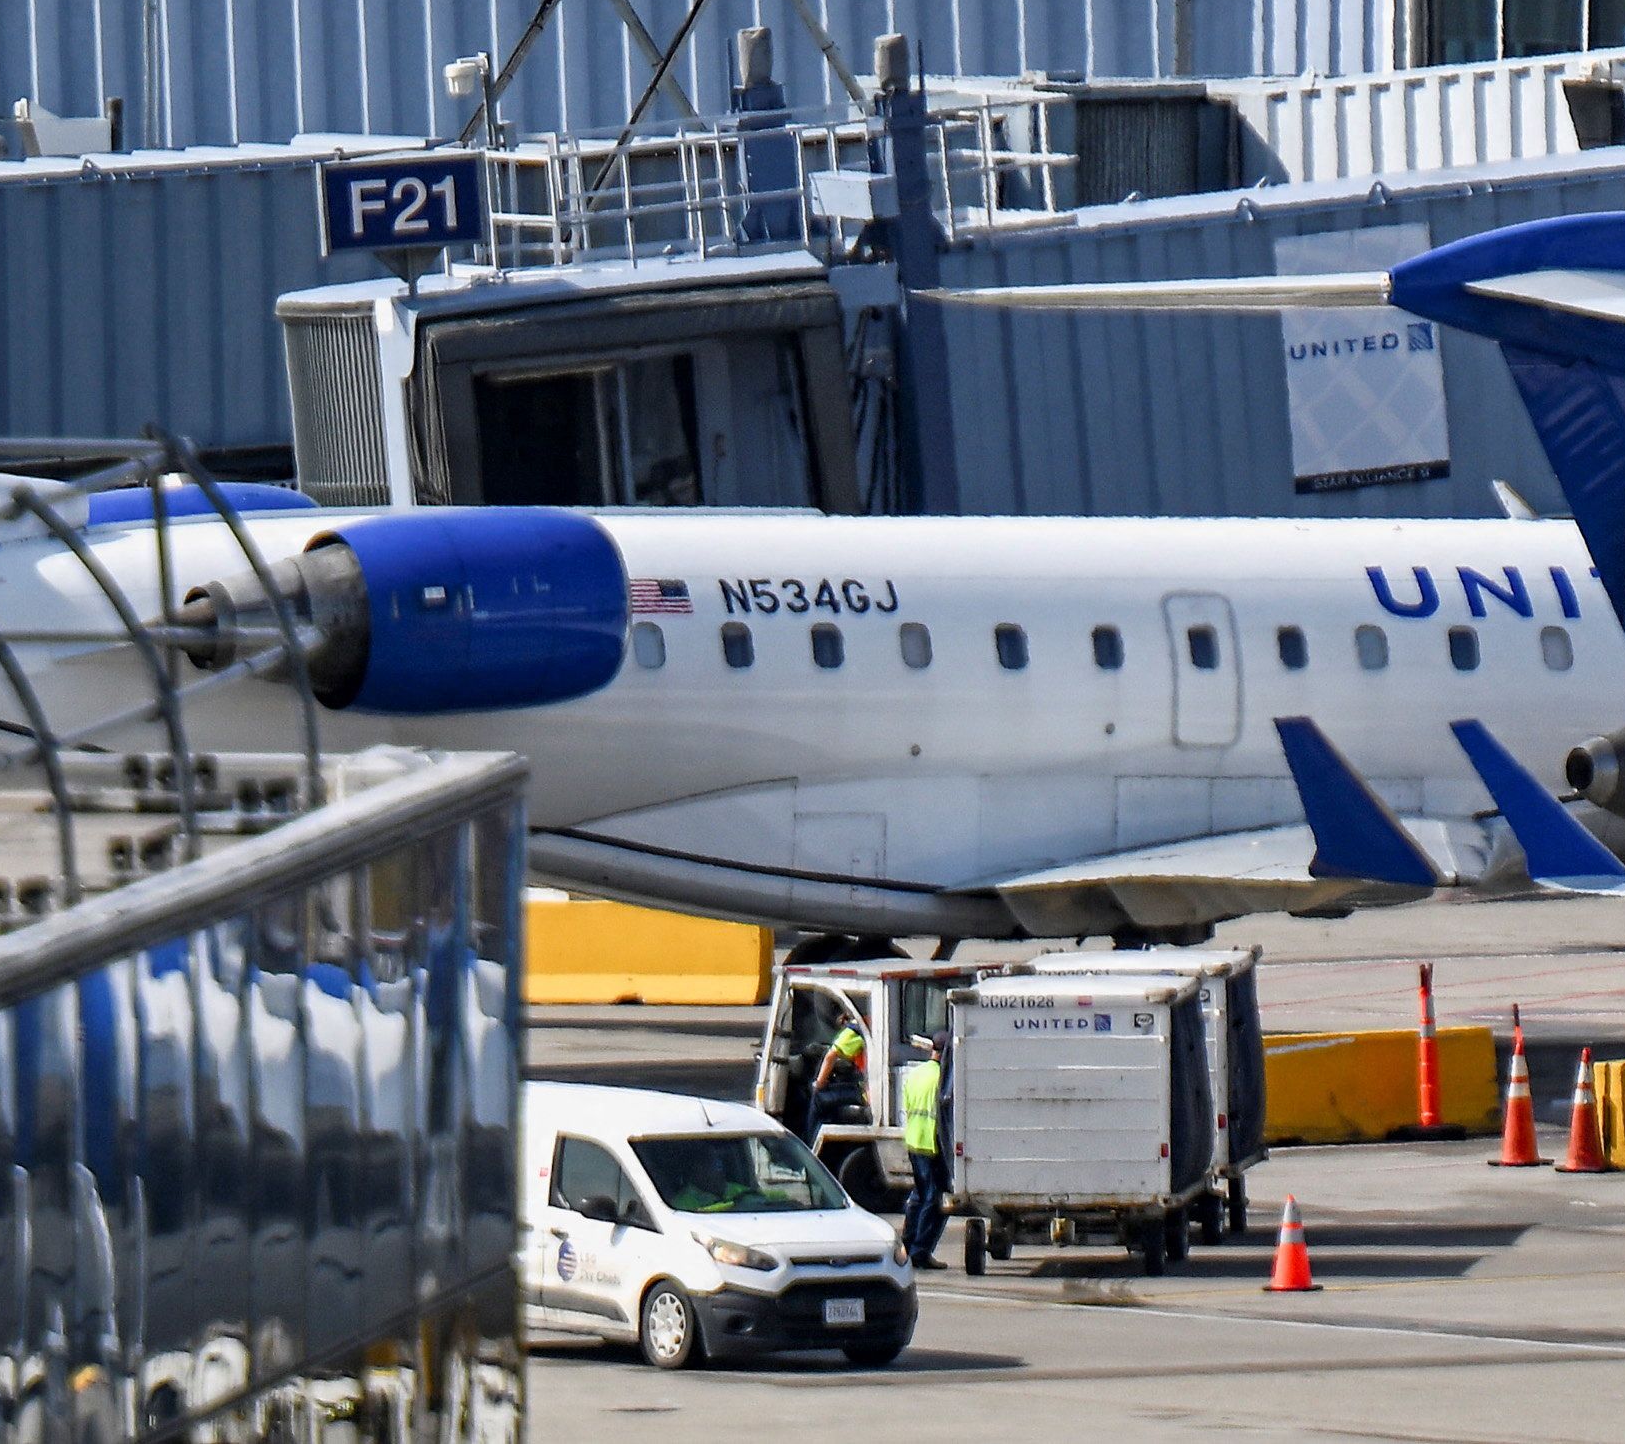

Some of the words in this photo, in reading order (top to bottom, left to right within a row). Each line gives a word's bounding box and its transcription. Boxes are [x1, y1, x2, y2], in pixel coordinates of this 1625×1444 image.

[350, 174, 458, 234] F21
[1290, 332, 1399, 360] UNITED
[718, 577, 899, 614] N534GJ
[1365, 566, 1600, 618] UNI
[1013, 1018, 1089, 1030] UNITED
